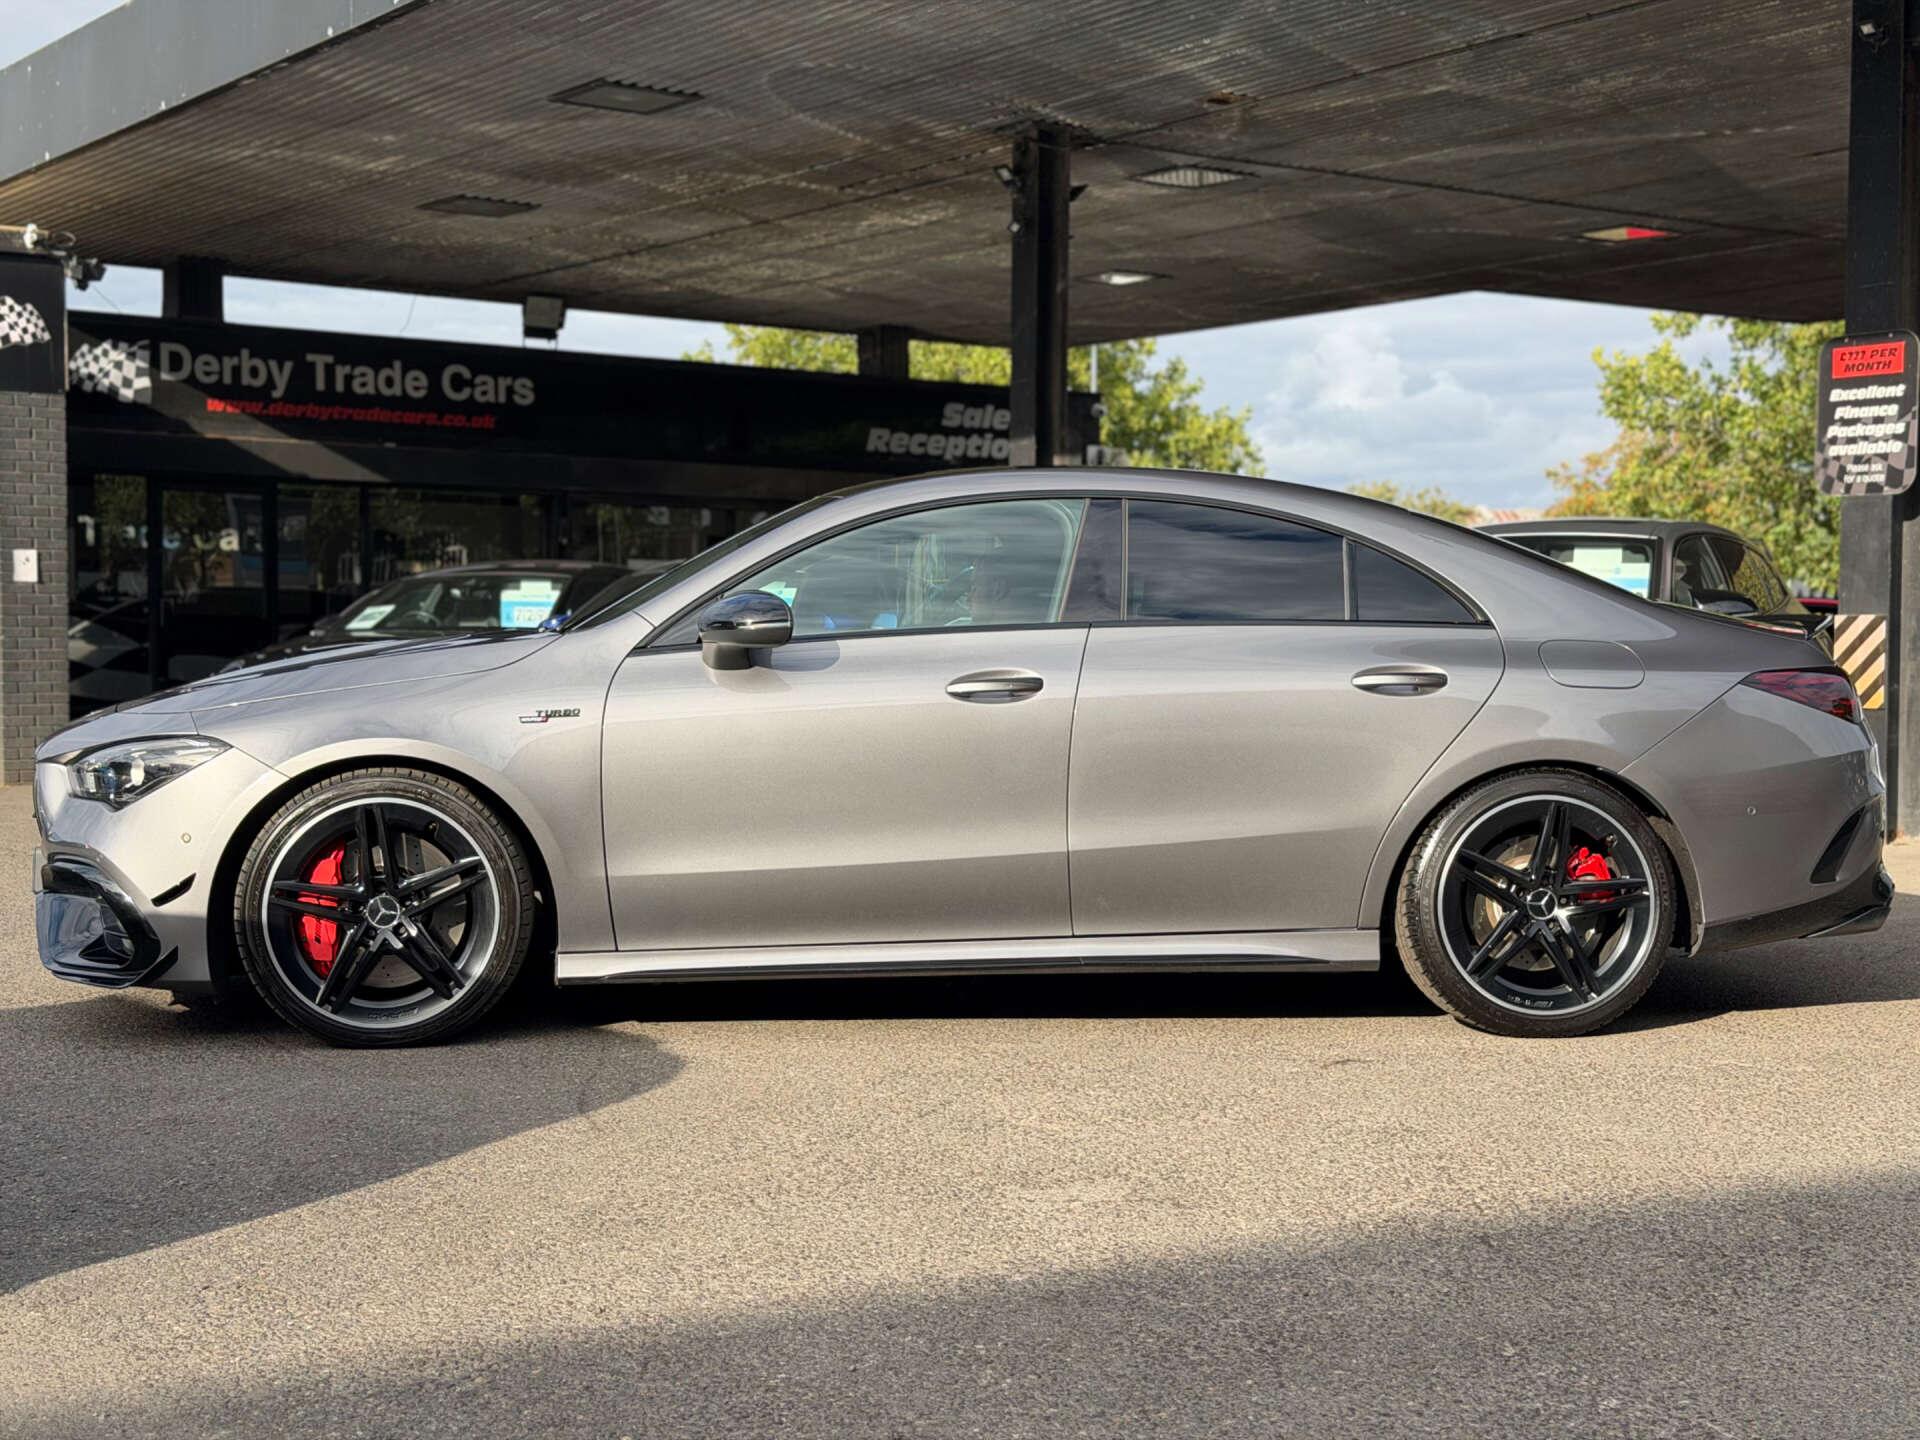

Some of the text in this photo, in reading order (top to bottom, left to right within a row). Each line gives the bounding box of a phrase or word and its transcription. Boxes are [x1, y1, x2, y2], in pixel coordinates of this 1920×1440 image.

[1870, 348, 1898, 358] PER
[159, 342, 536, 406] Derby Trade Cars
[1843, 360, 1892, 373] MONTH
[1829, 384, 1906, 402] Excellent
[206, 398, 496, 429] www.derbytradecars.co.uk
[941, 402, 1011, 431] Sale
[1834, 404, 1899, 420] Finance
[1827, 422, 1906, 438] Packages
[865, 427, 1009, 460] Receptio
[1828, 439, 1903, 456] available
[535, 708, 581, 718] TURBO
